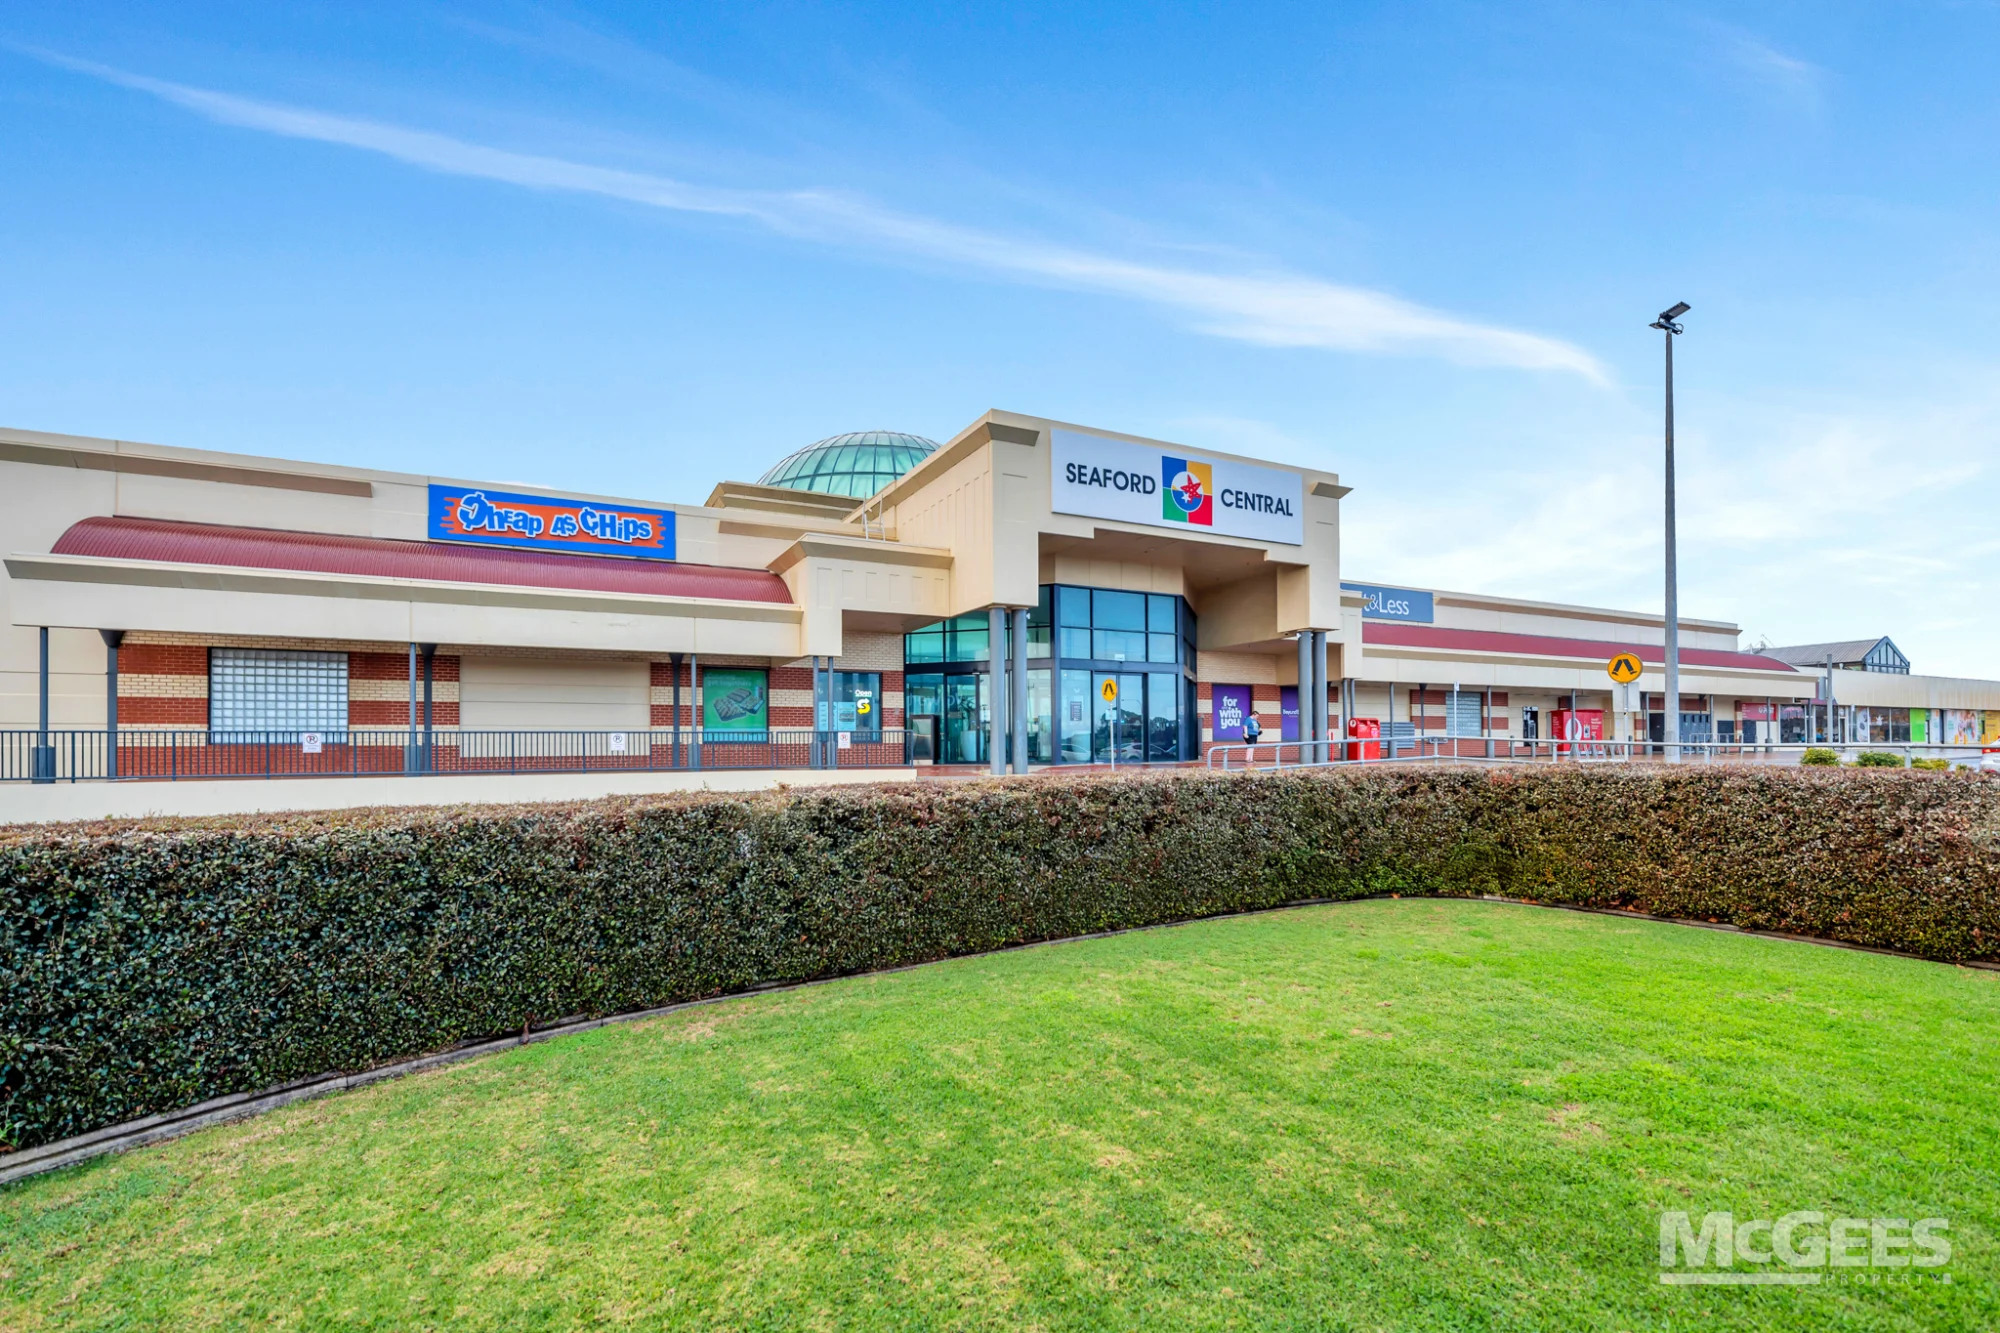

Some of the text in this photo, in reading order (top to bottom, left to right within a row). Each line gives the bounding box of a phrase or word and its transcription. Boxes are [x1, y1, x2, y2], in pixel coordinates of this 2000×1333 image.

[1065, 462, 1294, 517] SEAFORD CENTRAL
[1222, 695, 1238, 707] for
[1218, 707, 1242, 719] with
[1220, 718, 1241, 730] you
